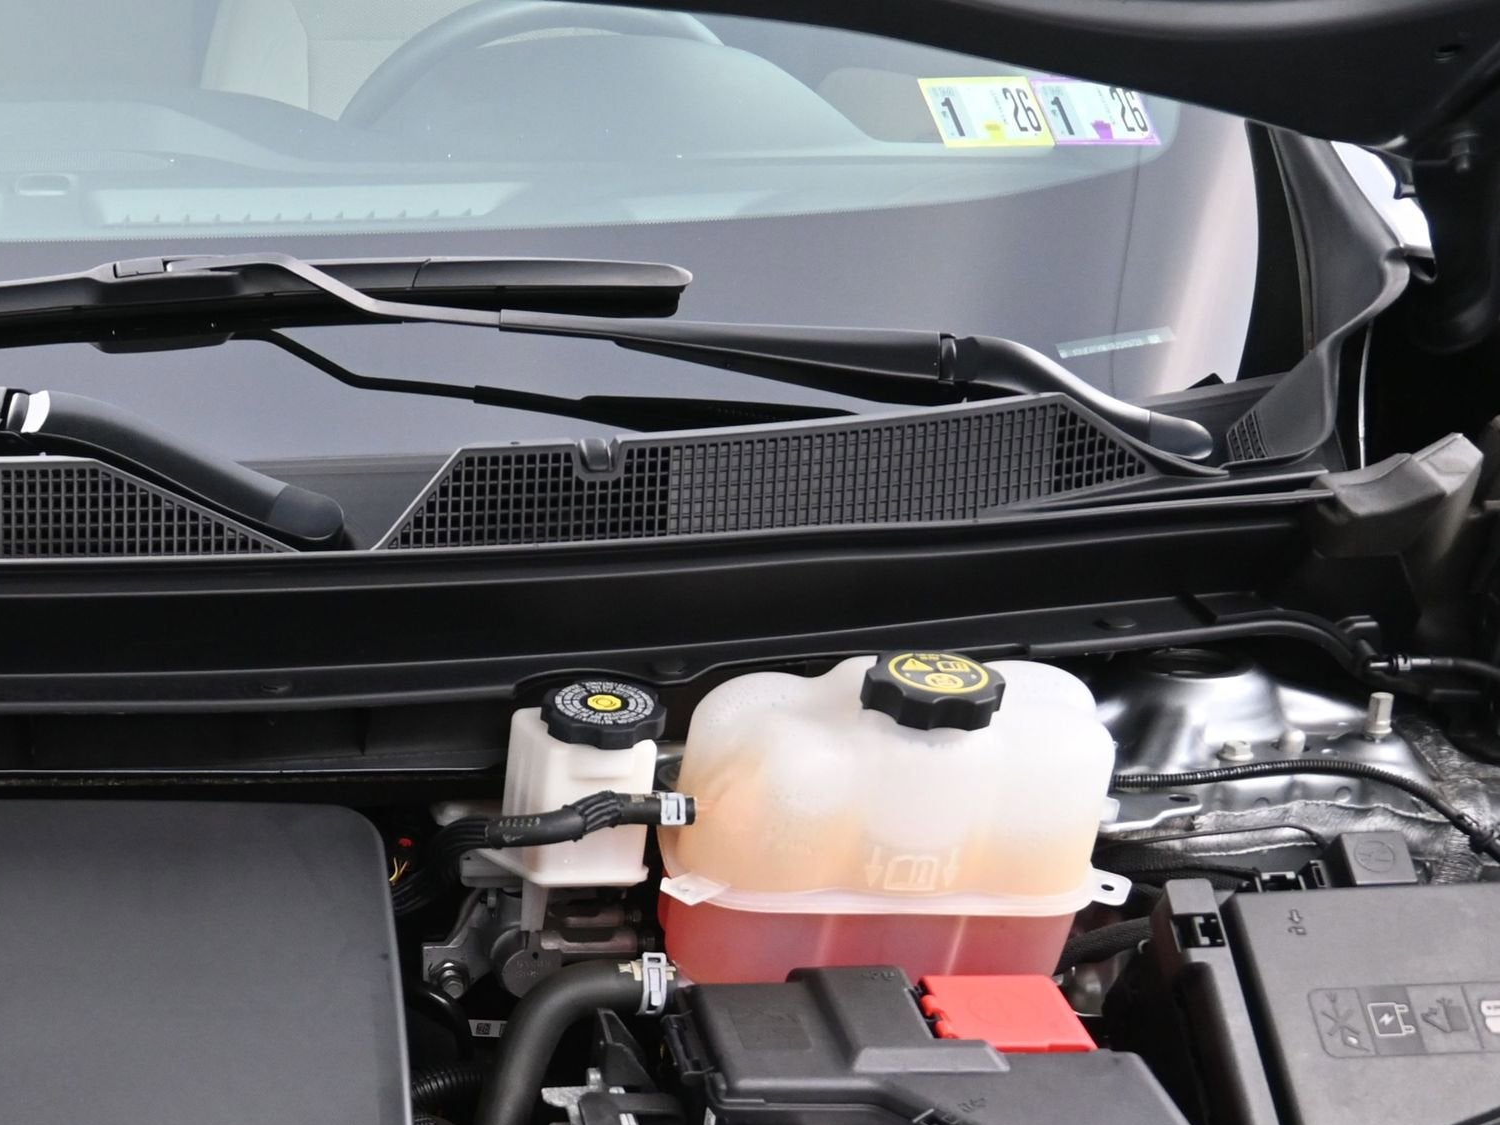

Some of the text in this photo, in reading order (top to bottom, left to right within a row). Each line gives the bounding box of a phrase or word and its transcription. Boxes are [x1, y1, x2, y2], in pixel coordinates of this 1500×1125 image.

[941, 97, 965, 136] 1
[1002, 87, 1042, 132] 26
[1051, 96, 1075, 135] 1
[1109, 86, 1148, 132] 26
